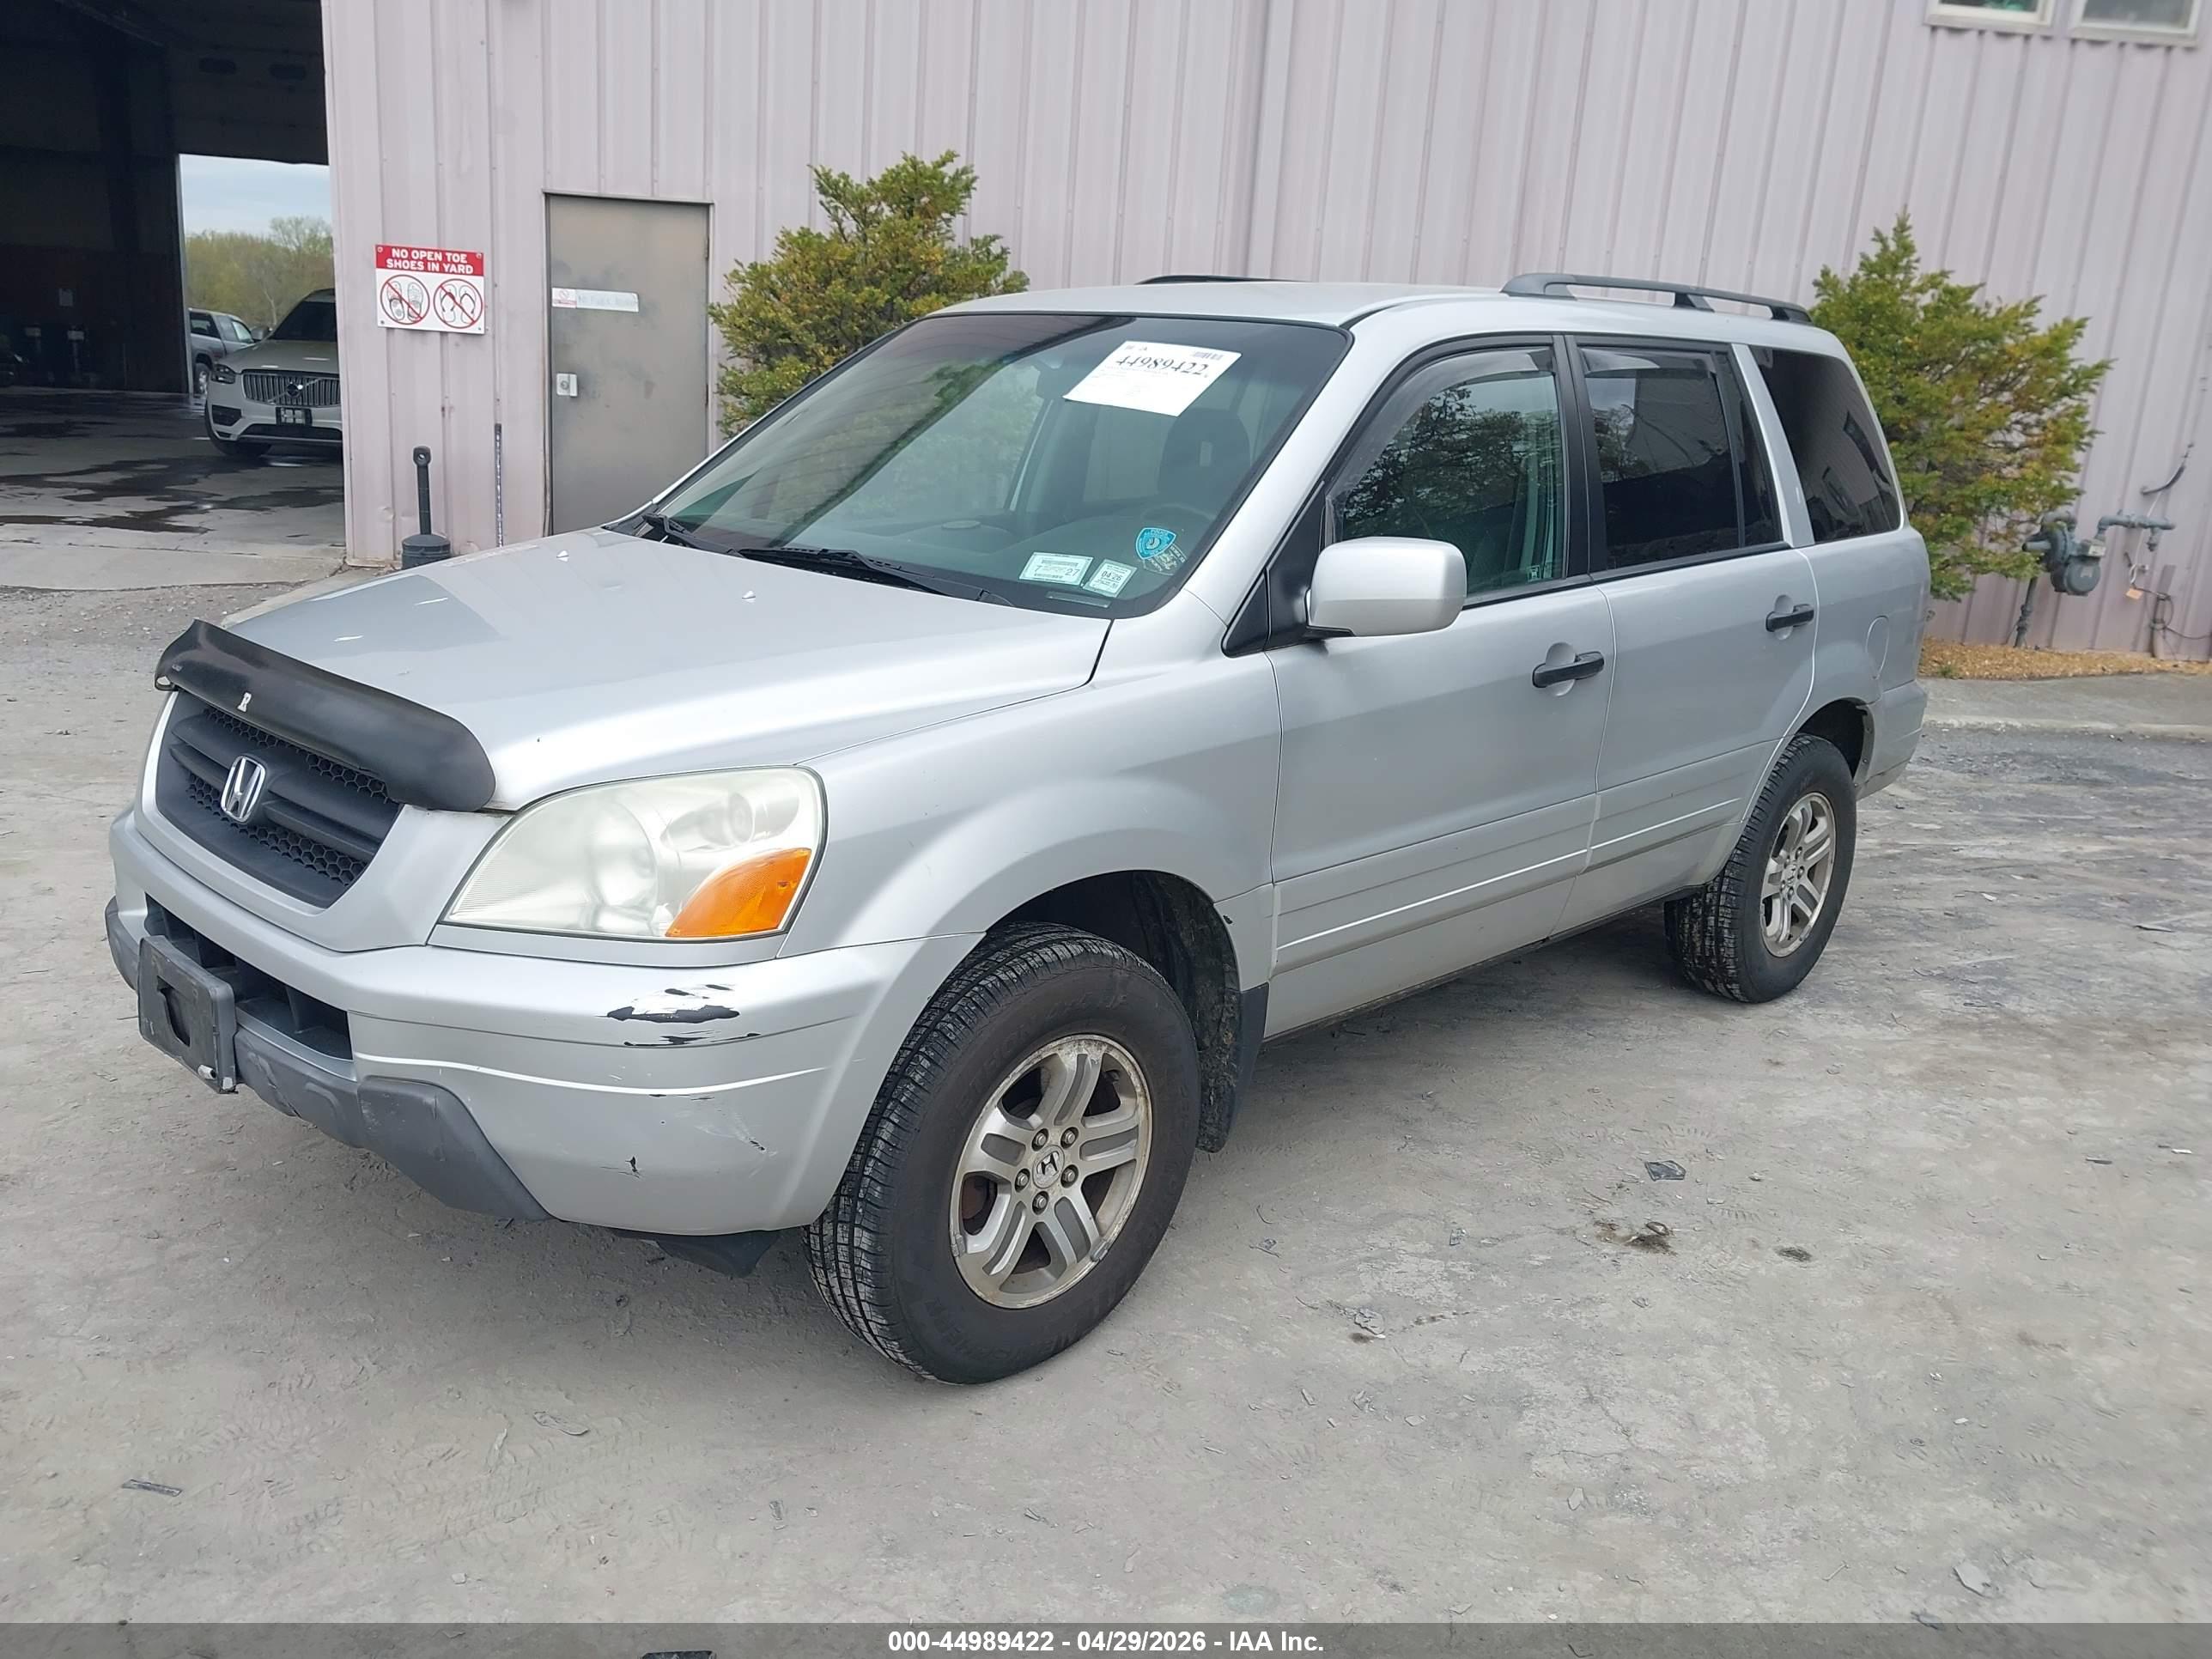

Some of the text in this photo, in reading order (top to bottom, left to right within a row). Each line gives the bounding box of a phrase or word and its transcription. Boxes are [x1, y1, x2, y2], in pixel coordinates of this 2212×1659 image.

[392, 248, 467, 264] NO OPEN TOE
[386, 258, 473, 274] SHOES IN YARD
[1116, 356, 1208, 375] 44989422
